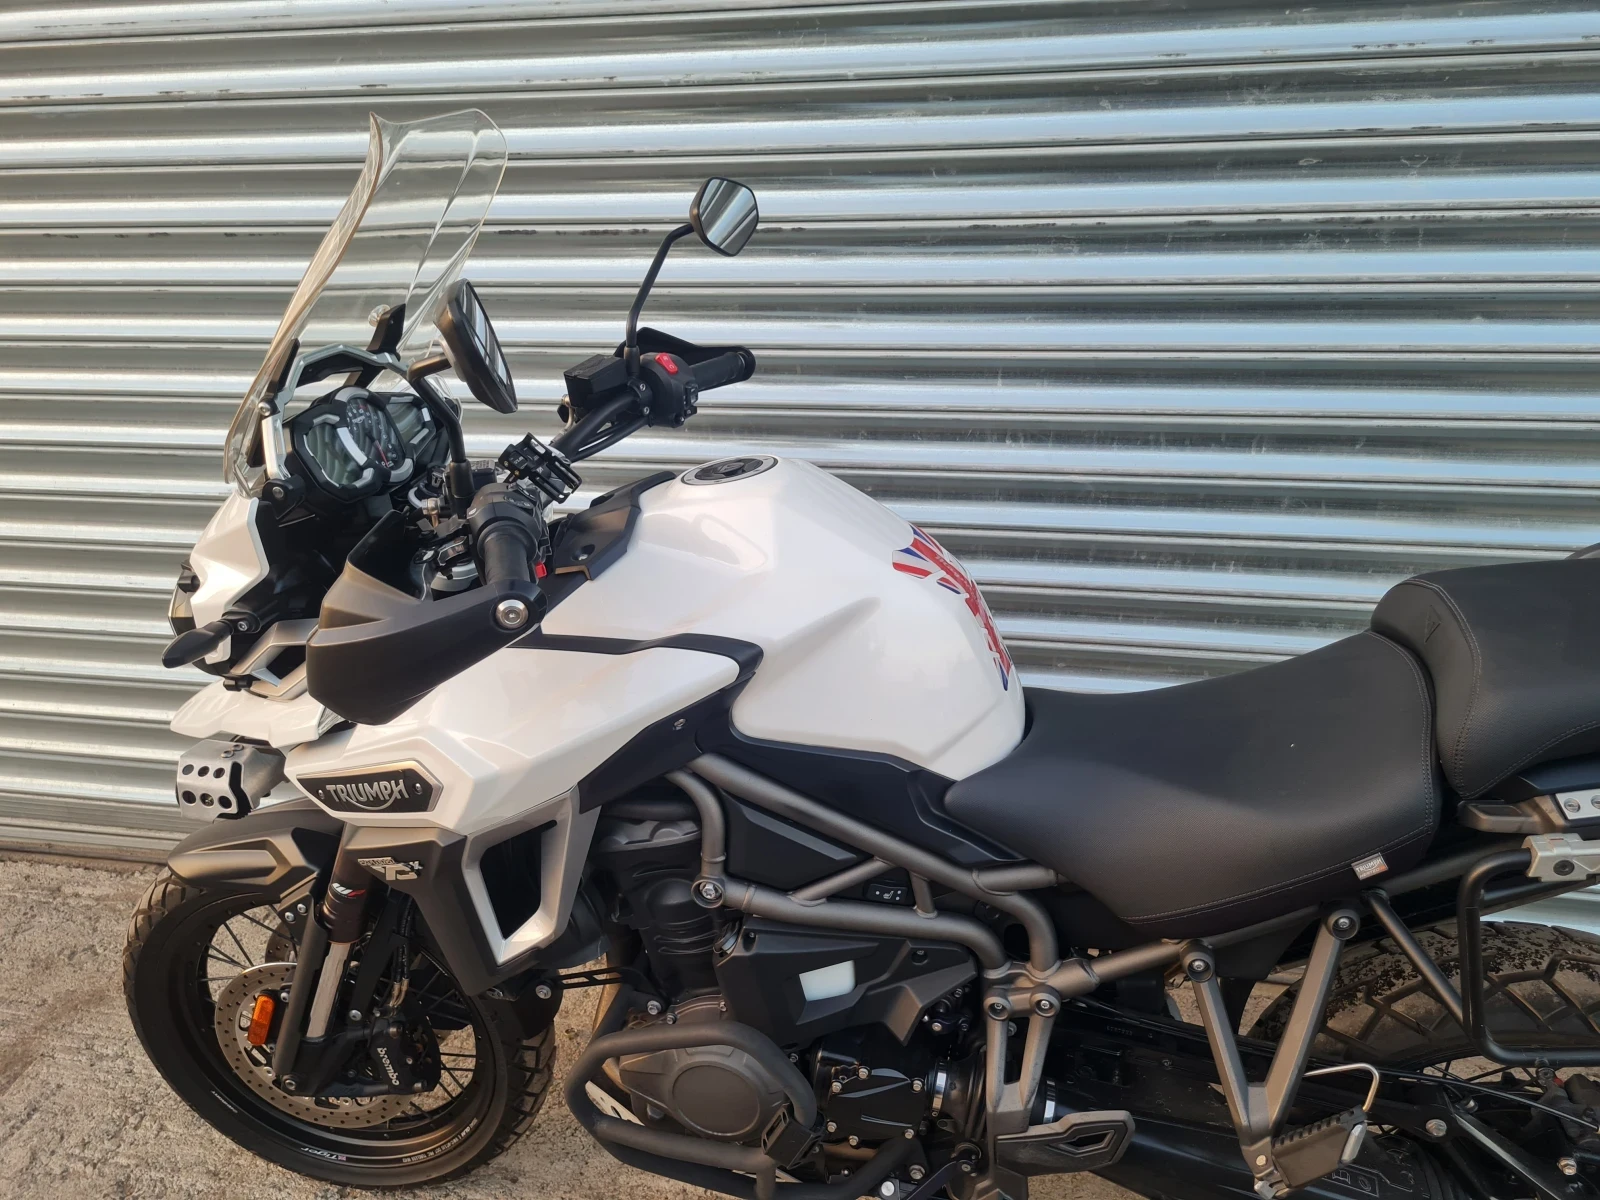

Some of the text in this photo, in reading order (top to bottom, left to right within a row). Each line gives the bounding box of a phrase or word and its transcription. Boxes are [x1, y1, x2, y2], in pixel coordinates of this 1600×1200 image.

[325, 779, 410, 811] TRIUMPH
[1355, 857, 1384, 873] TRIUMPH
[376, 1047, 400, 1086] brembo
[300, 1147, 338, 1161] Tiger
